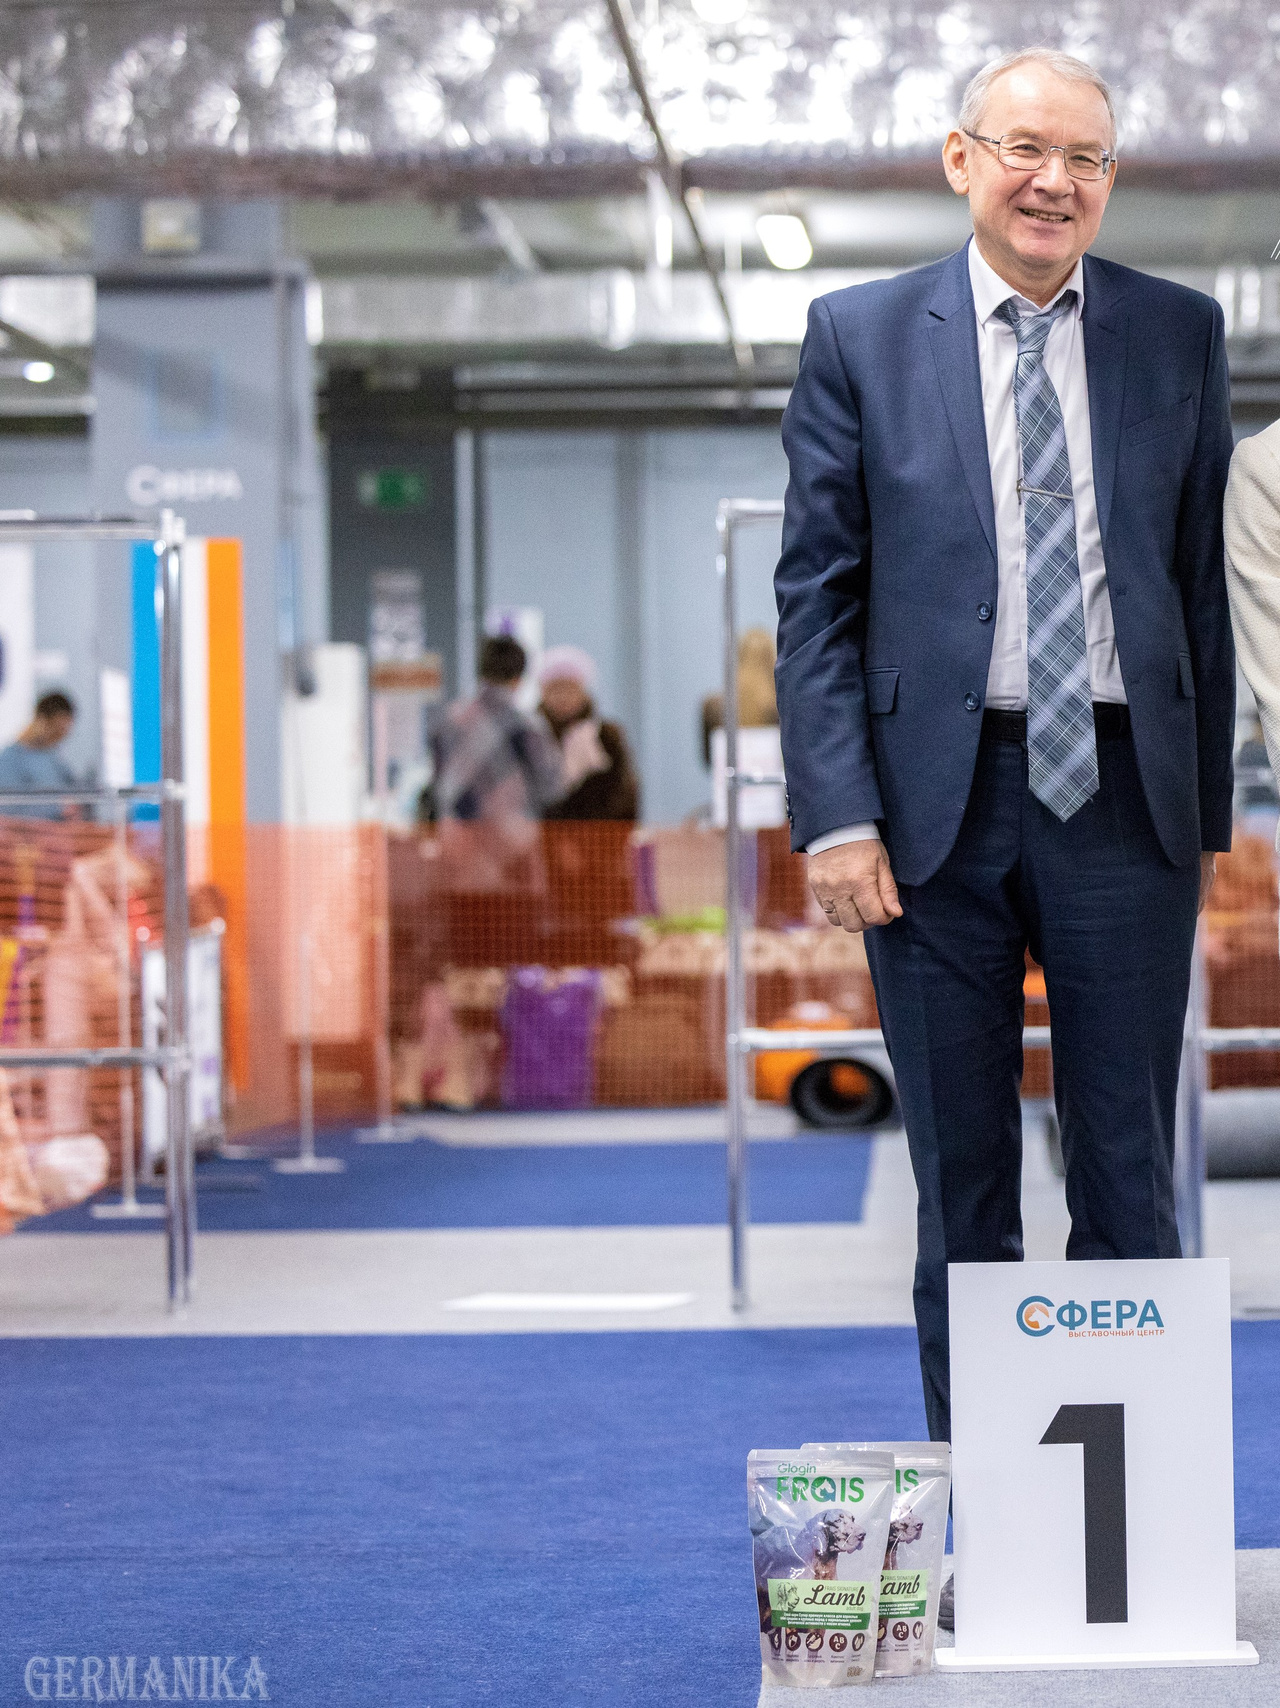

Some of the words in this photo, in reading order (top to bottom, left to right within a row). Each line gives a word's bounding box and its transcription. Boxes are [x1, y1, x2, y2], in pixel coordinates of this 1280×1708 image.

[1016, 1295, 1165, 1337] СФЕРА
[1068, 1329, 1135, 1338] ВЫСТАВОЧНЫЙ
[1137, 1329, 1165, 1338] ЦЕНТР
[777, 1462, 816, 1476] Glogin
[1038, 1403, 1128, 1623] 1
[803, 1584, 865, 1606] Lamb
